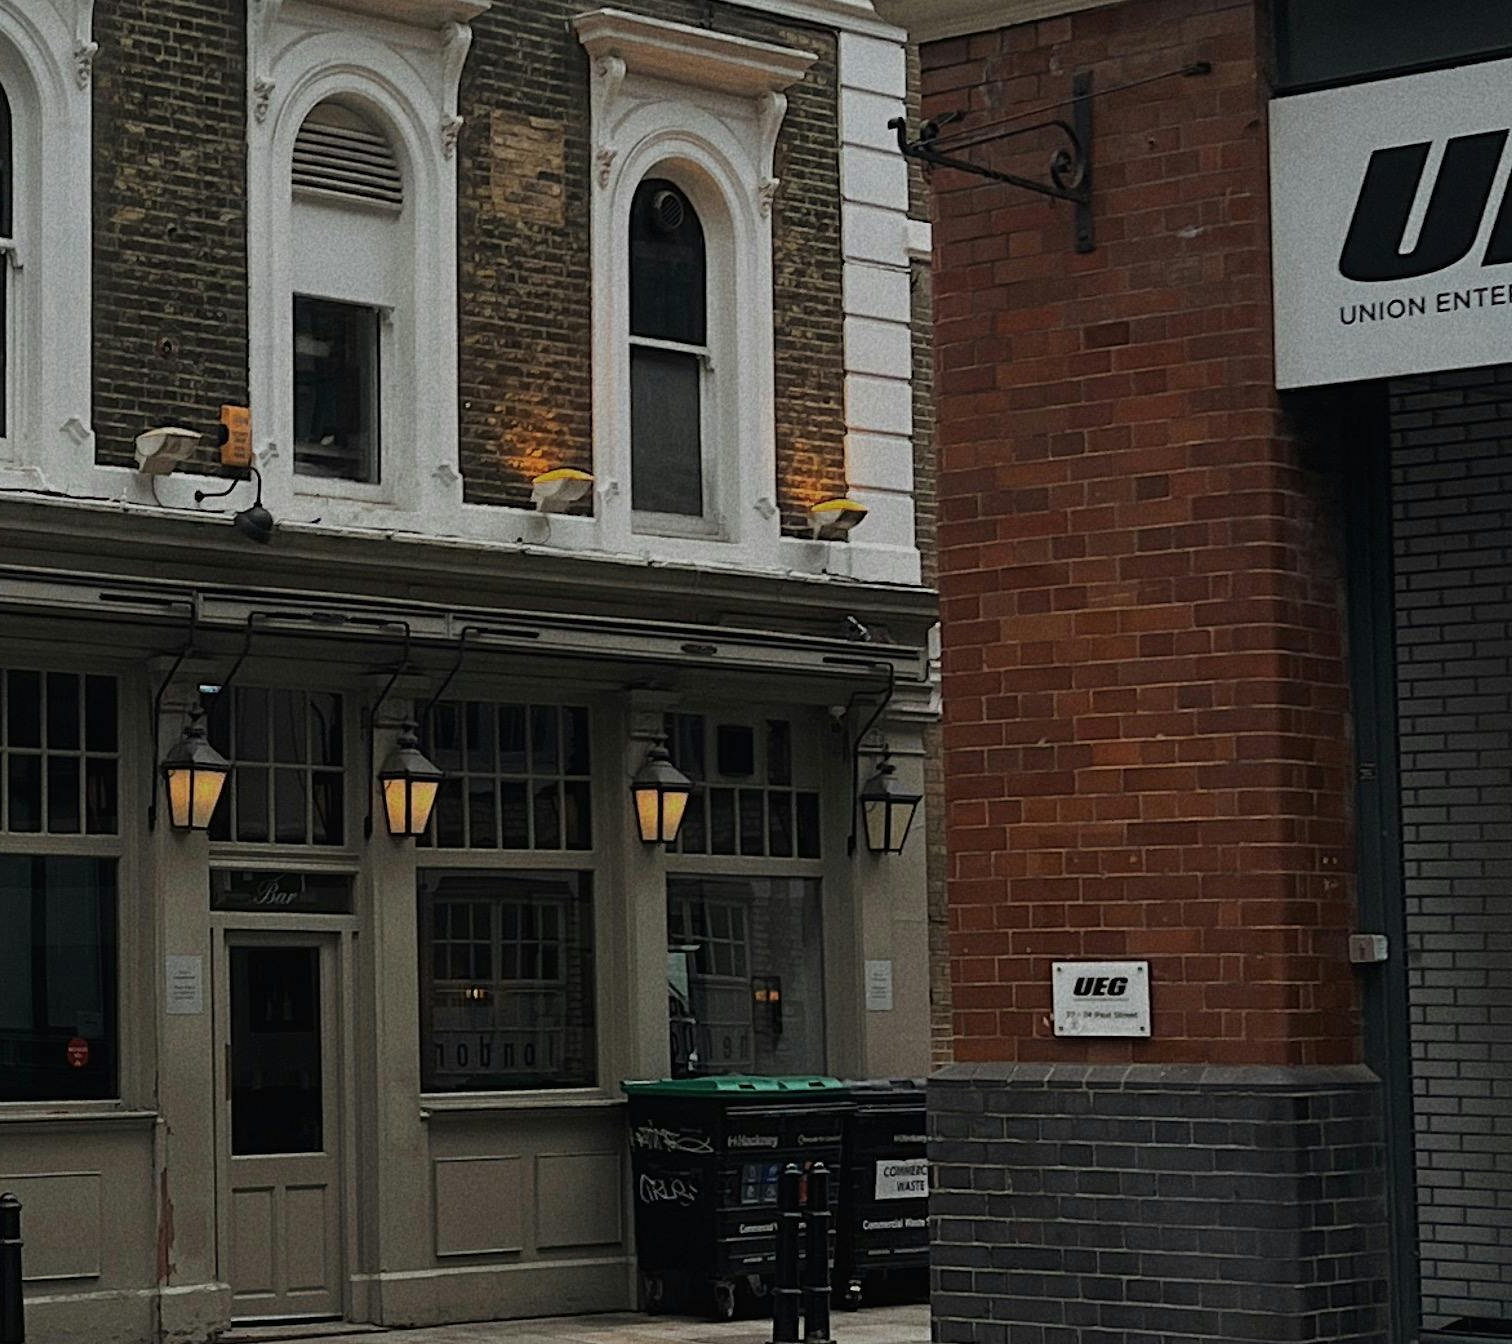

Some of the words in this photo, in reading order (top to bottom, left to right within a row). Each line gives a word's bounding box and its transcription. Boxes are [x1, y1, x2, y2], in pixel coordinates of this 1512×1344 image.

[1339, 296, 1426, 326] UNION
[1436, 284, 1512, 313] ENTE
[253, 876, 298, 905] Bar
[1073, 977, 1129, 996] UEG
[897, 1181, 925, 1192] WASTE
